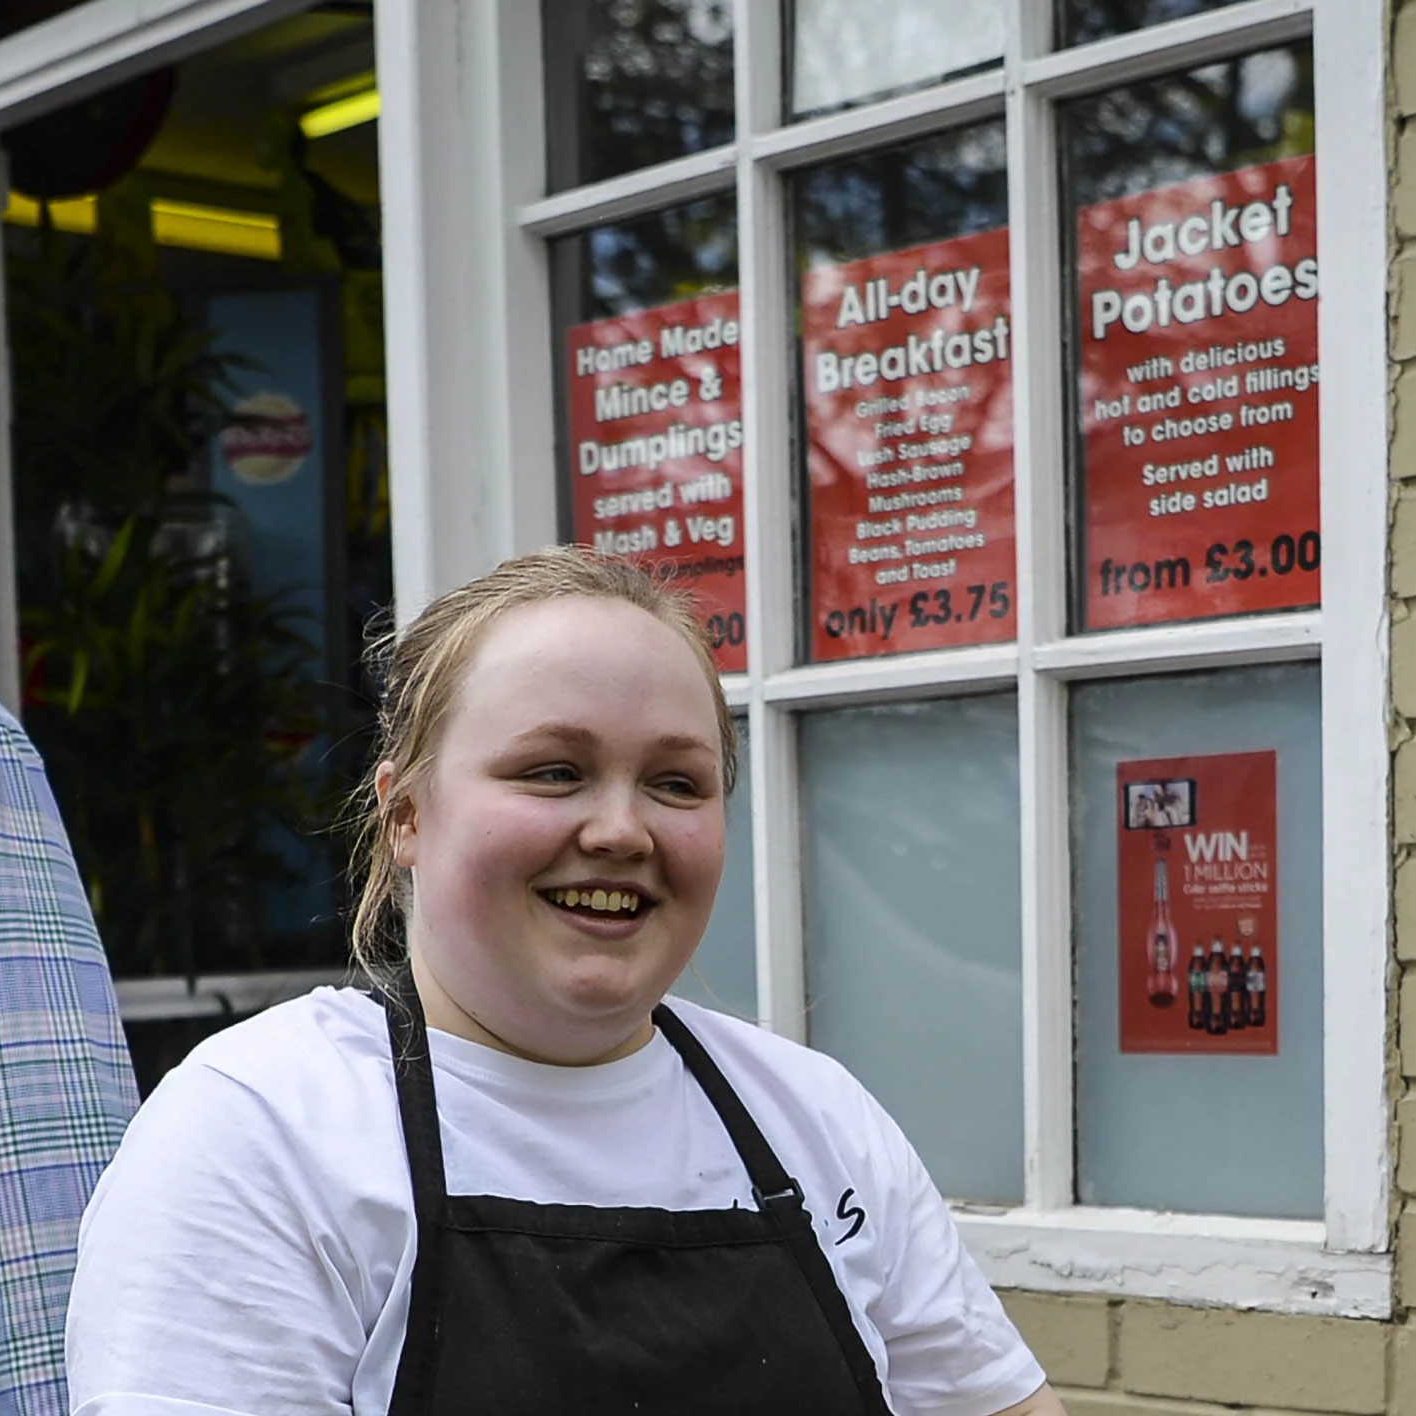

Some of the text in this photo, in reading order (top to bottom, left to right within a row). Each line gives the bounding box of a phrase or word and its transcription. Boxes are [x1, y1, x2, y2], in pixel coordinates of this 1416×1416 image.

[1113, 184, 1293, 270] Jacket
[836, 267, 981, 329] All-day
[1091, 258, 1319, 341] Potatoes
[576, 318, 740, 376] Home Made
[816, 316, 1010, 393] Breakfast
[1127, 338, 1286, 383] with delicious
[595, 364, 723, 422] Mince &
[856, 386, 970, 418] Grilled Bacon
[1094, 363, 1320, 420] hot and cold fillings
[875, 414, 954, 440] Fried Egg
[1123, 402, 1293, 446] to choose from
[578, 419, 744, 475] Dumplings
[898, 435, 972, 460] Sausage
[1142, 446, 1275, 486] Served with
[593, 472, 732, 520] served with
[868, 486, 963, 513] Mushrooms
[1149, 478, 1268, 517] side salad
[594, 515, 734, 556] Mash & Veg
[856, 508, 978, 540] Black Pudding
[904, 532, 986, 557] Tomatoes
[875, 558, 958, 586] and Toast
[1100, 530, 1321, 597] from £3.00
[825, 581, 1011, 640] only £3.75
[1184, 831, 1247, 863] WIN
[1194, 861, 1268, 881] MILLION
